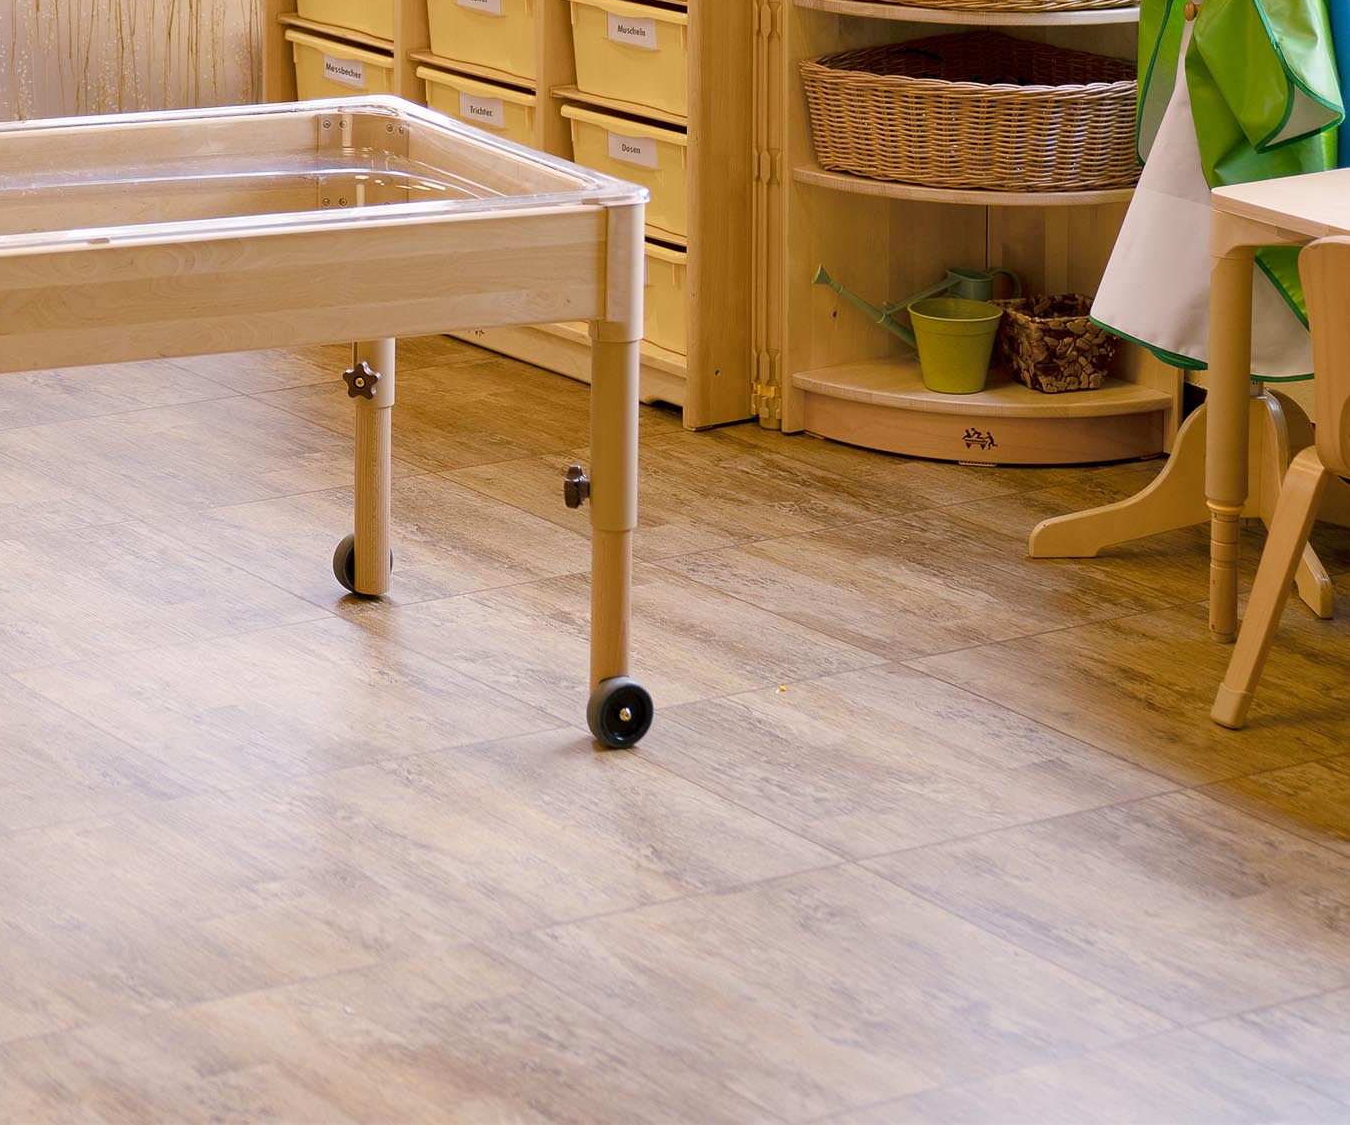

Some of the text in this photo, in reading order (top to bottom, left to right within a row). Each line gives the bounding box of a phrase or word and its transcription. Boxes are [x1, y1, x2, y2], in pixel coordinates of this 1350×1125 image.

[616, 23, 646, 38] Muscheln
[325, 62, 362, 81] Messbecher
[469, 104, 493, 117] Trichter
[621, 143, 642, 155] Dosen
